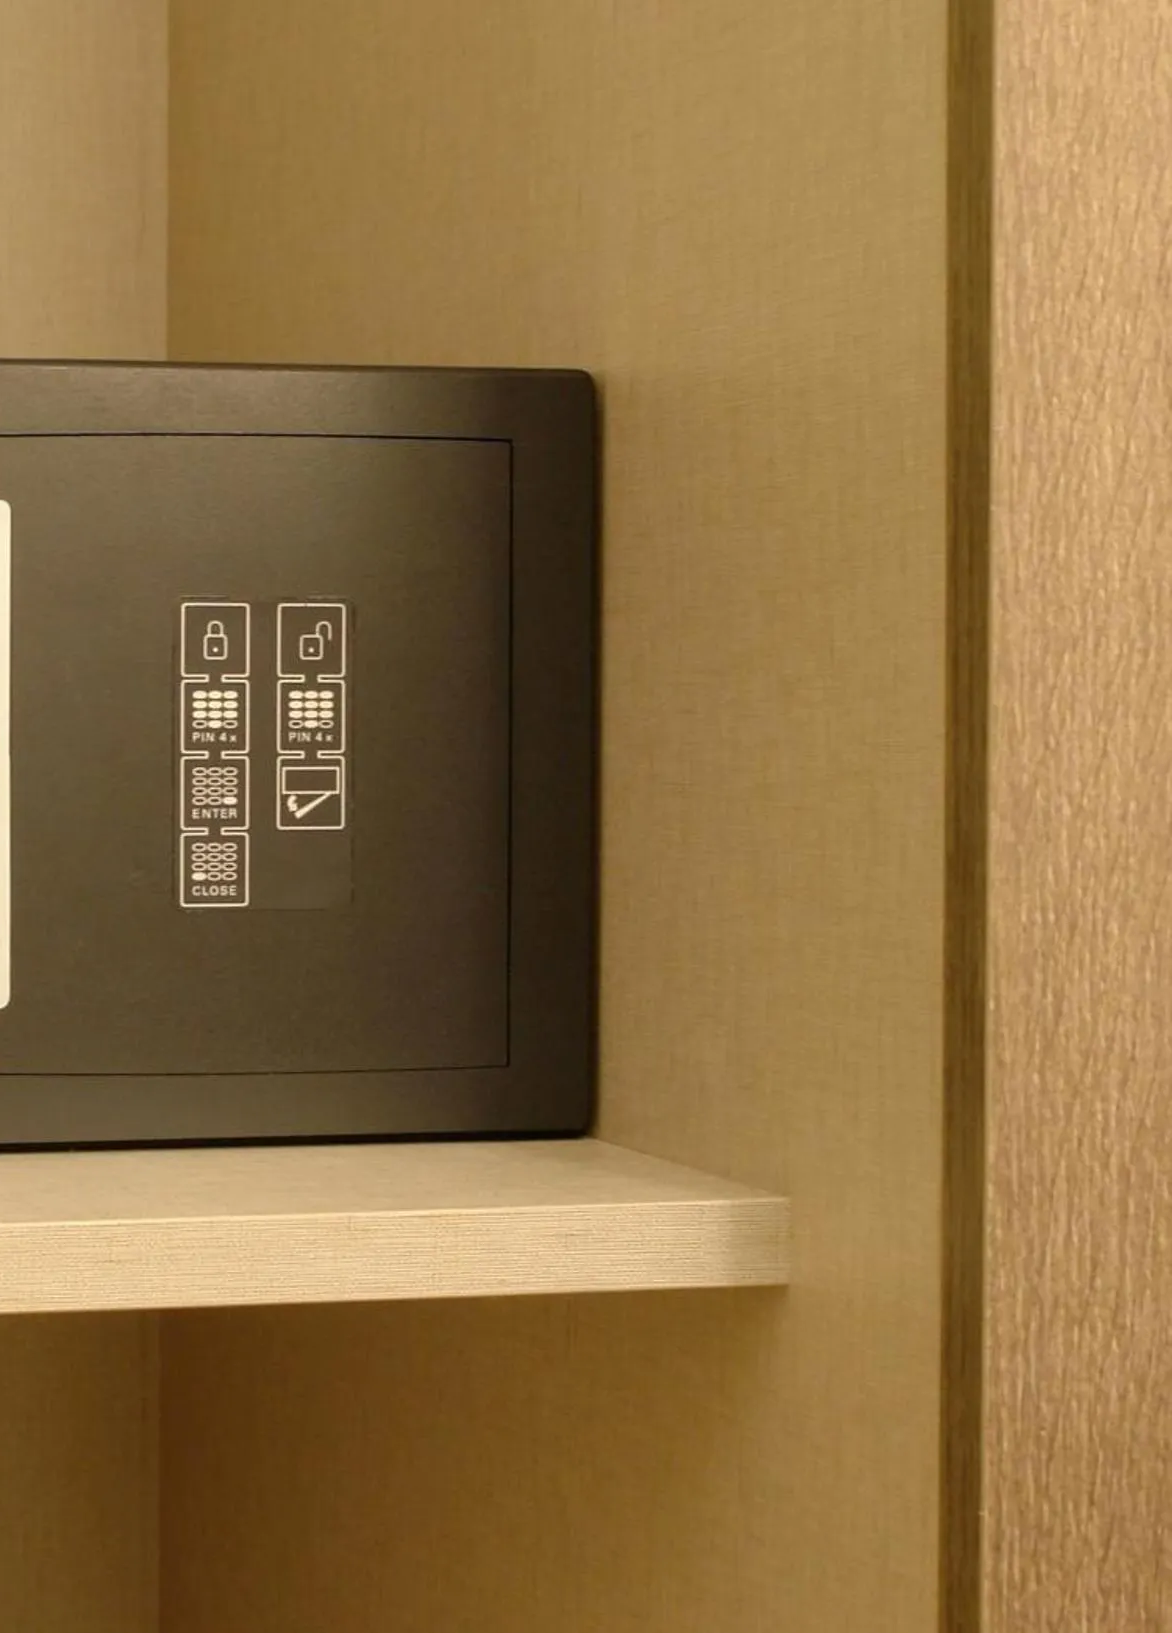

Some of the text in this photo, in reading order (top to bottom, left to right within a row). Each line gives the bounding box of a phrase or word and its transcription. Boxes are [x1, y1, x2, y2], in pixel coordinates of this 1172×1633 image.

[192, 732, 215, 743] PIN
[288, 732, 311, 743] PIN
[192, 808, 237, 819] ENTER
[192, 886, 237, 896] CLOSE
